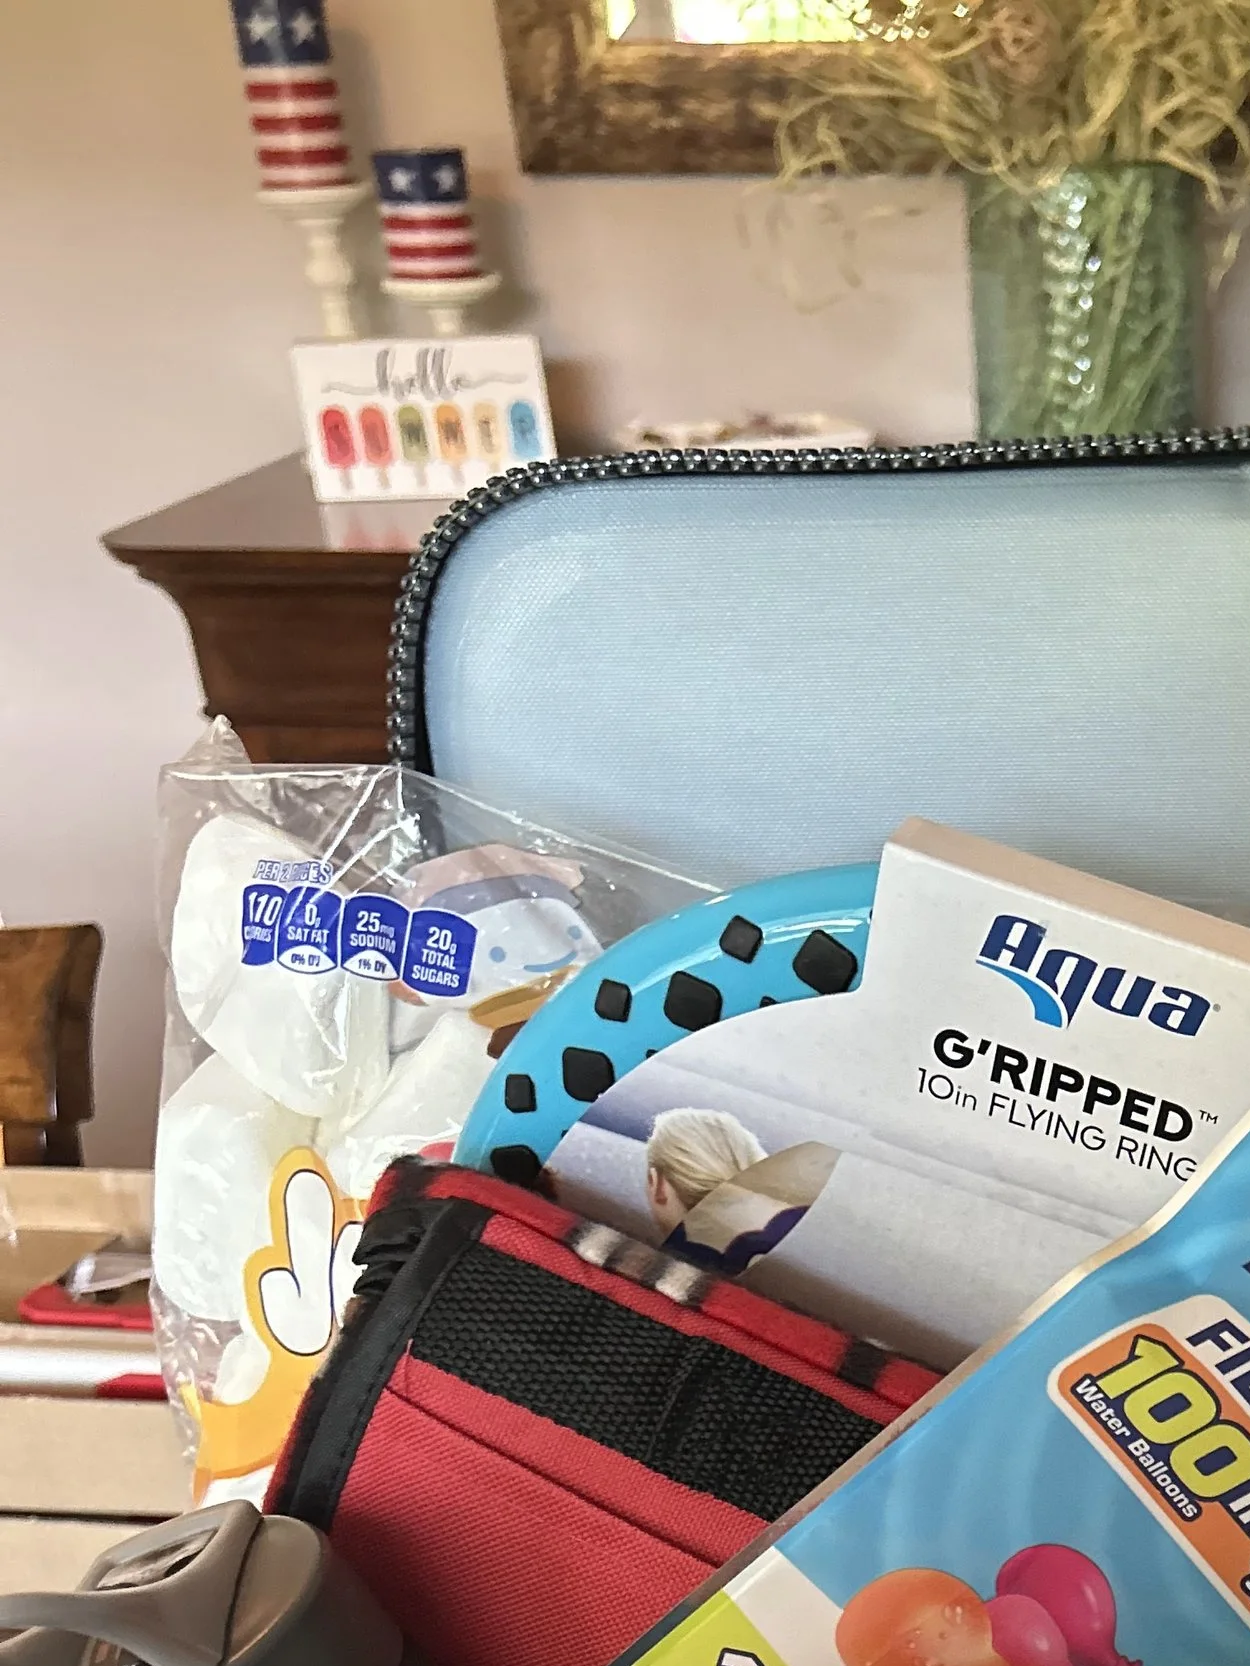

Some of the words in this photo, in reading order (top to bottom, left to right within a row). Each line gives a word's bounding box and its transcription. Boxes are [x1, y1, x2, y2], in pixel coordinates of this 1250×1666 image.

[248, 891, 282, 926] 110
[287, 926, 309, 941] SAT
[311, 929, 329, 944] FAT
[350, 934, 396, 953] SODIUM
[427, 926, 457, 952] 20g
[422, 949, 456, 970] TOTAL
[411, 964, 460, 988] SUGARS
[976, 914, 1211, 1037] Aqua
[988, 1092, 1106, 1151] FLYING
[1115, 1135, 1198, 1182] RING
[1075, 1379, 1132, 1440] Water
[1126, 1437, 1199, 1520] Balloons
